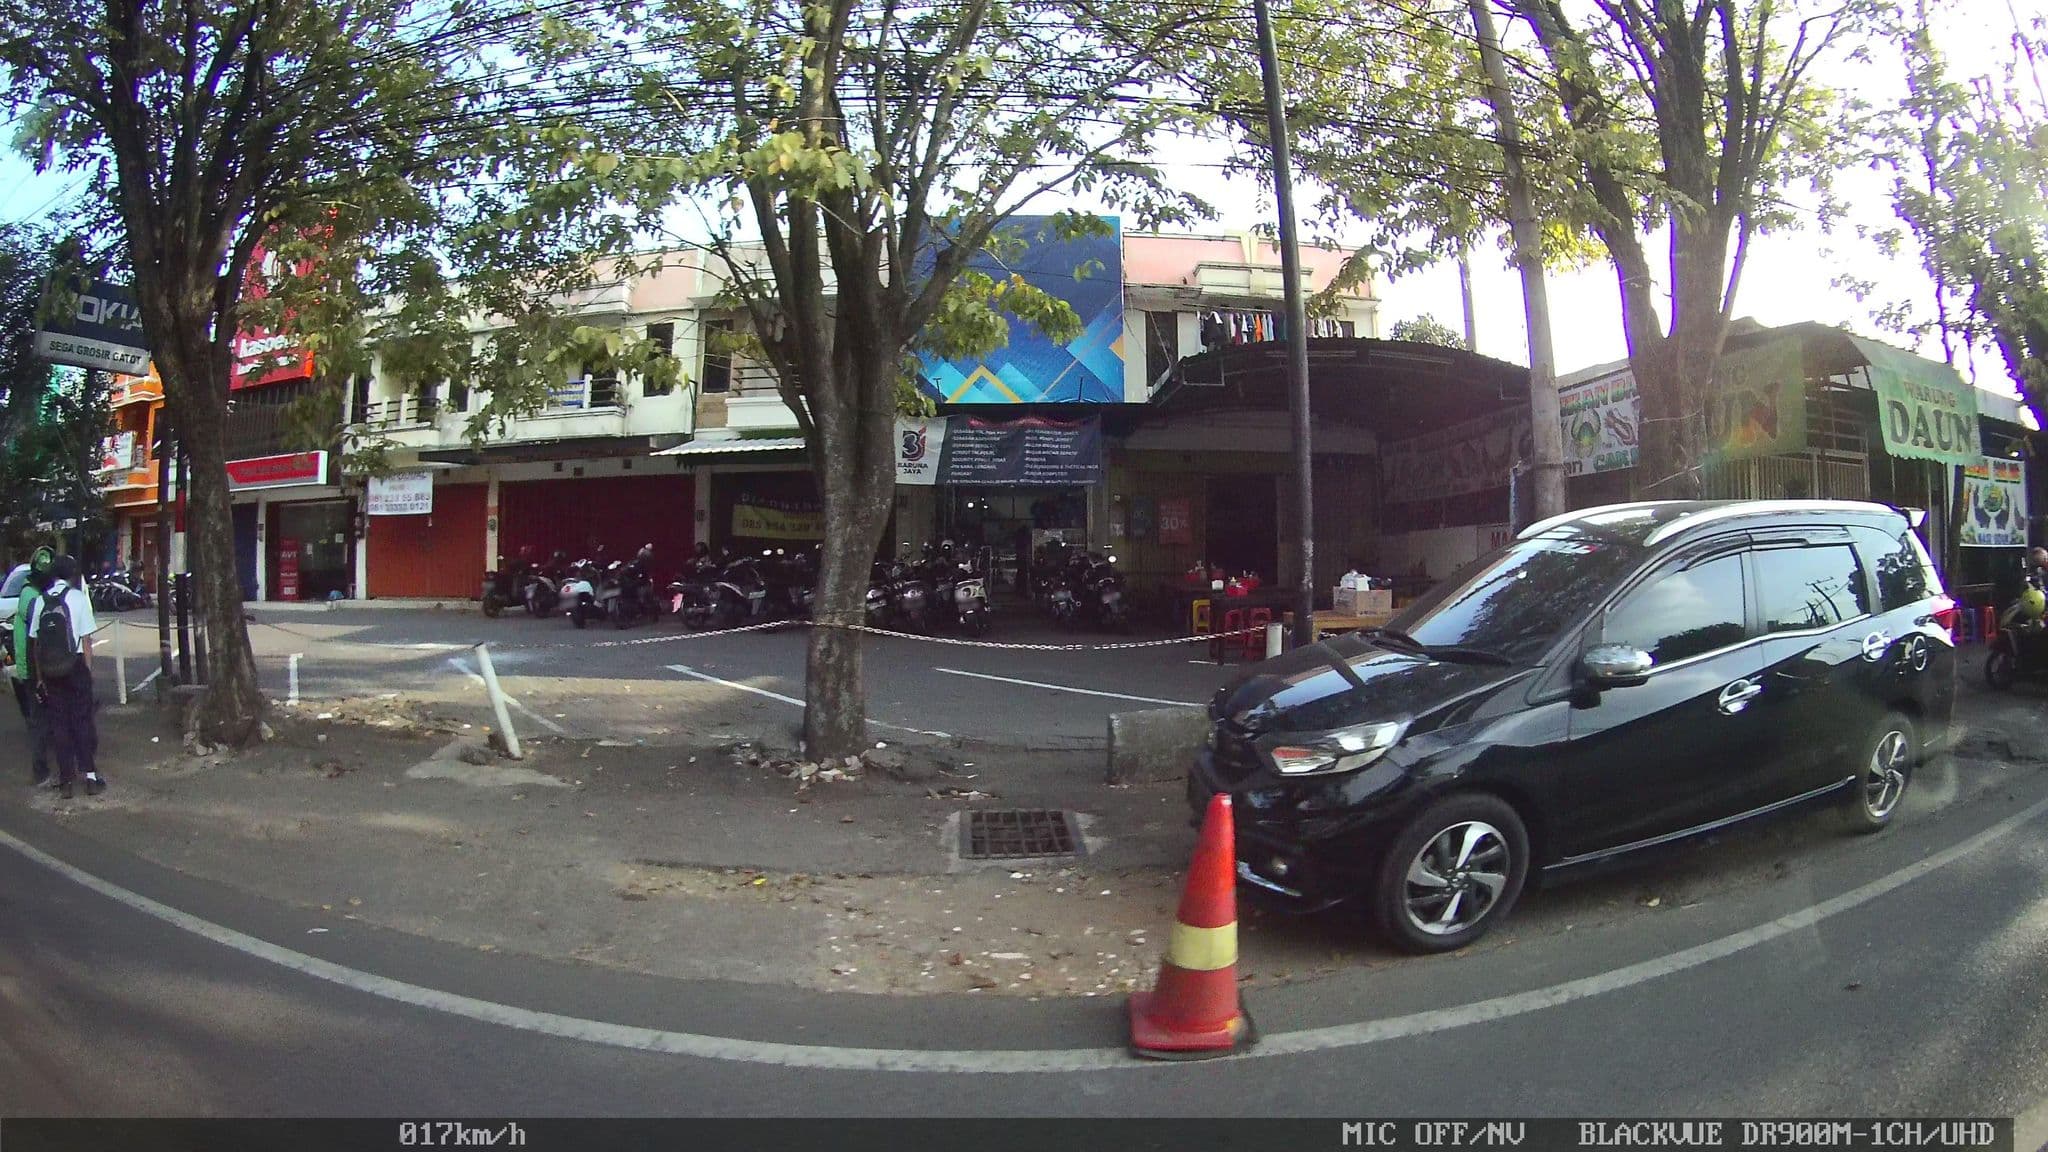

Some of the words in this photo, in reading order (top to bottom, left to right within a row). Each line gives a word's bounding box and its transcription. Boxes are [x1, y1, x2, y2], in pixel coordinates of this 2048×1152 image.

[70, 292, 143, 331] OKIA
[76, 345, 110, 360] GROSIR
[112, 352, 142, 365] GATOT
[1904, 381, 1956, 408] WARUNG
[1887, 399, 1972, 452] DAUN
